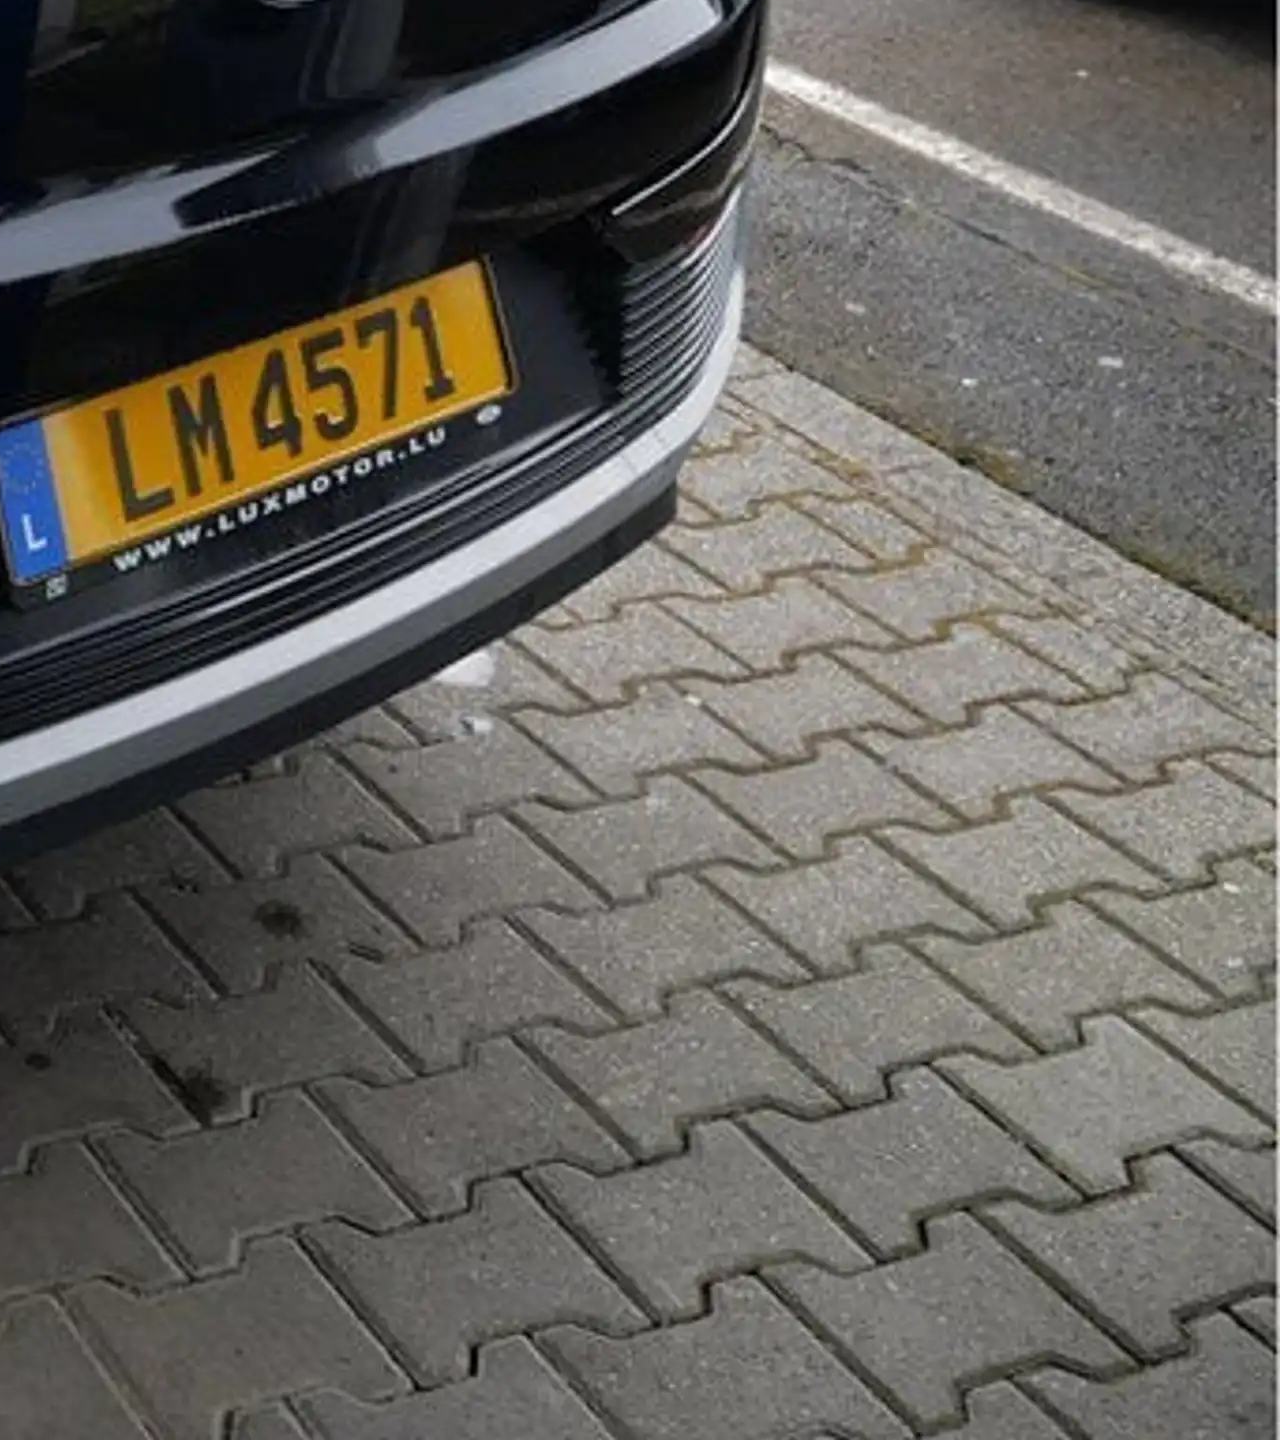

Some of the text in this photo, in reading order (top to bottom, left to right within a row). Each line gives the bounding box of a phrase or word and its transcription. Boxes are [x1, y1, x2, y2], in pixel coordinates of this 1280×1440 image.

[250, 294, 456, 460] 4571
[20, 512, 48, 552] L
[113, 427, 447, 573] WWW.LUXMOTOR.LU
